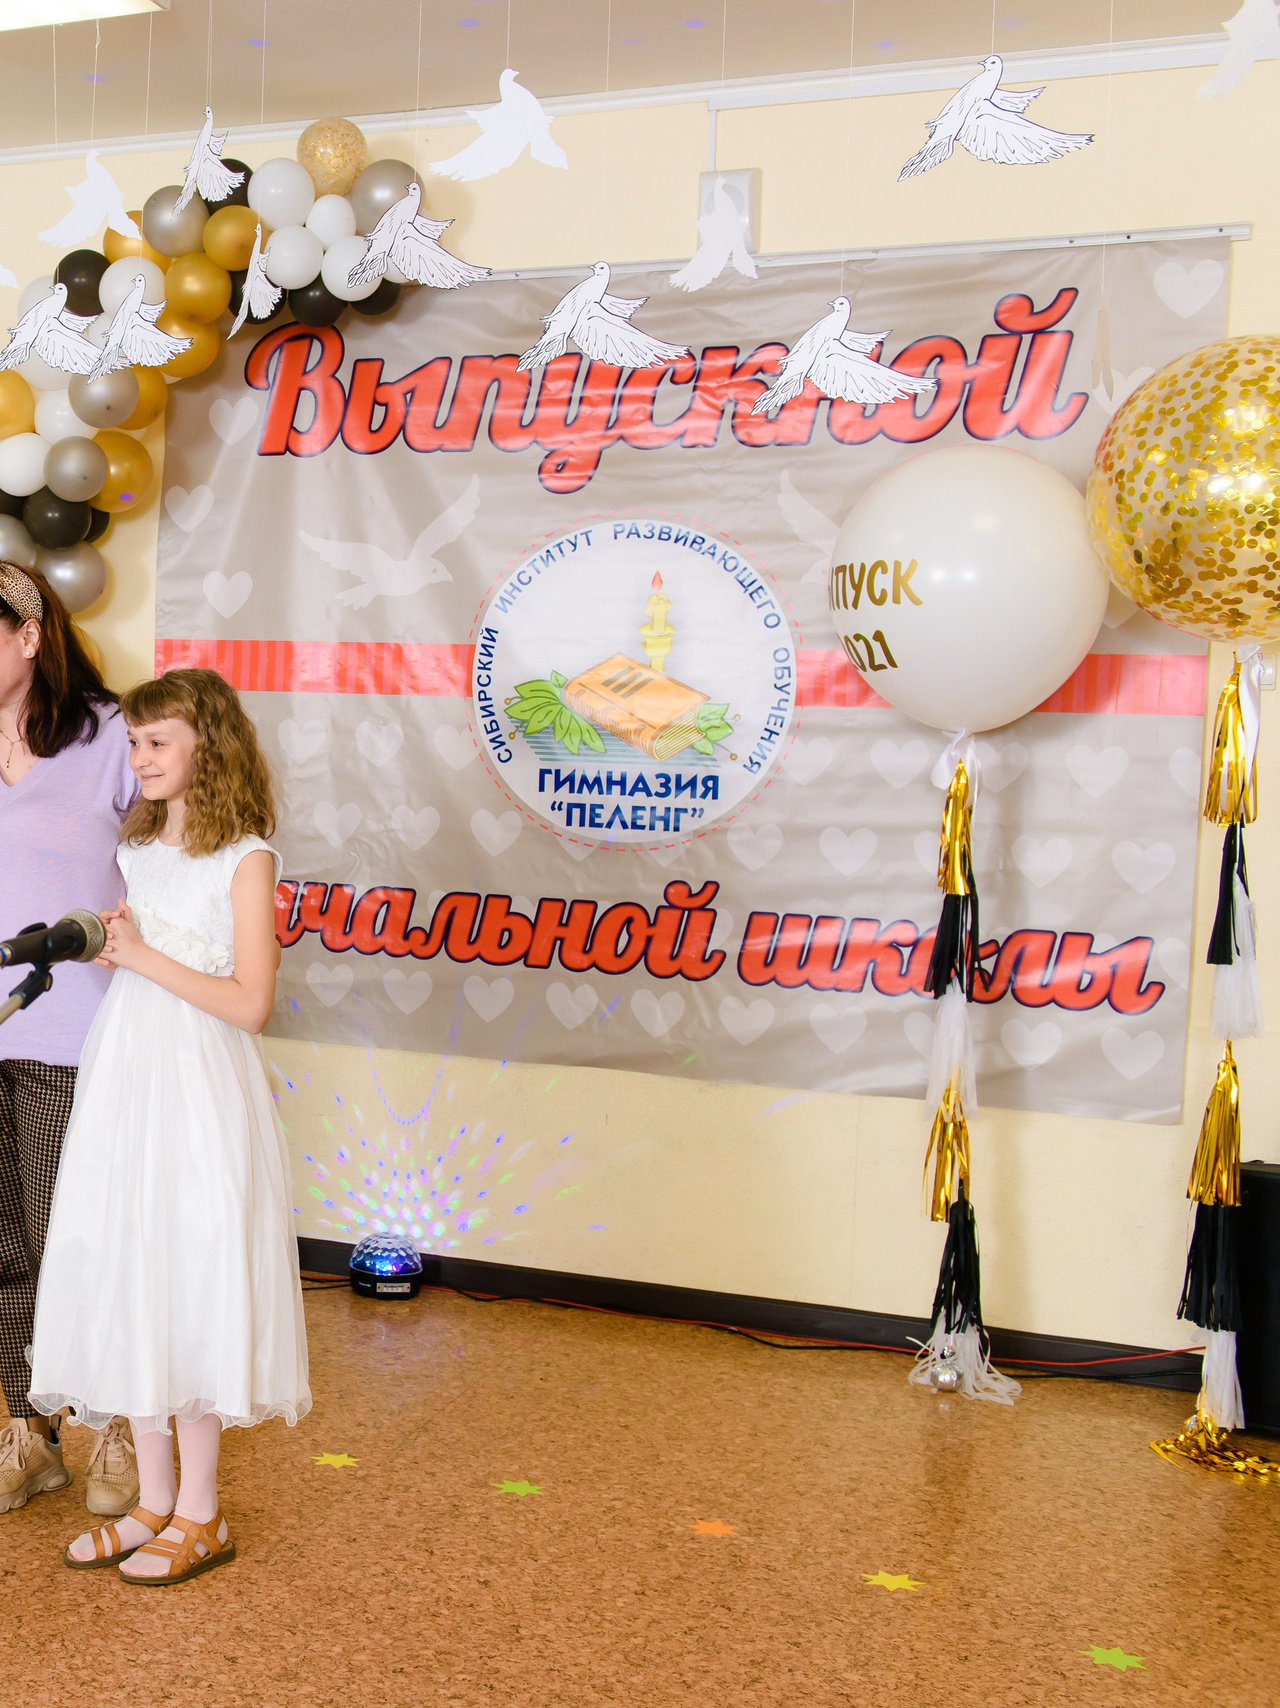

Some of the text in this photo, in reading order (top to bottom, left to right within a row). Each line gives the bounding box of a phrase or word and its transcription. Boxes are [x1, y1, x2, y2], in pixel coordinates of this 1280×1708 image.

[828, 558, 924, 611] ПУСК
[477, 522, 792, 776] СИБИРСКИЙ ИНСТИТУТ РАЗВИВАЮЩЕГО ОБУЧЕНИЯ
[836, 629, 899, 673] 021
[538, 768, 720, 801] ГИМНАЗИЯ
[550, 800, 705, 832] “ПЕЛЕНГ”
